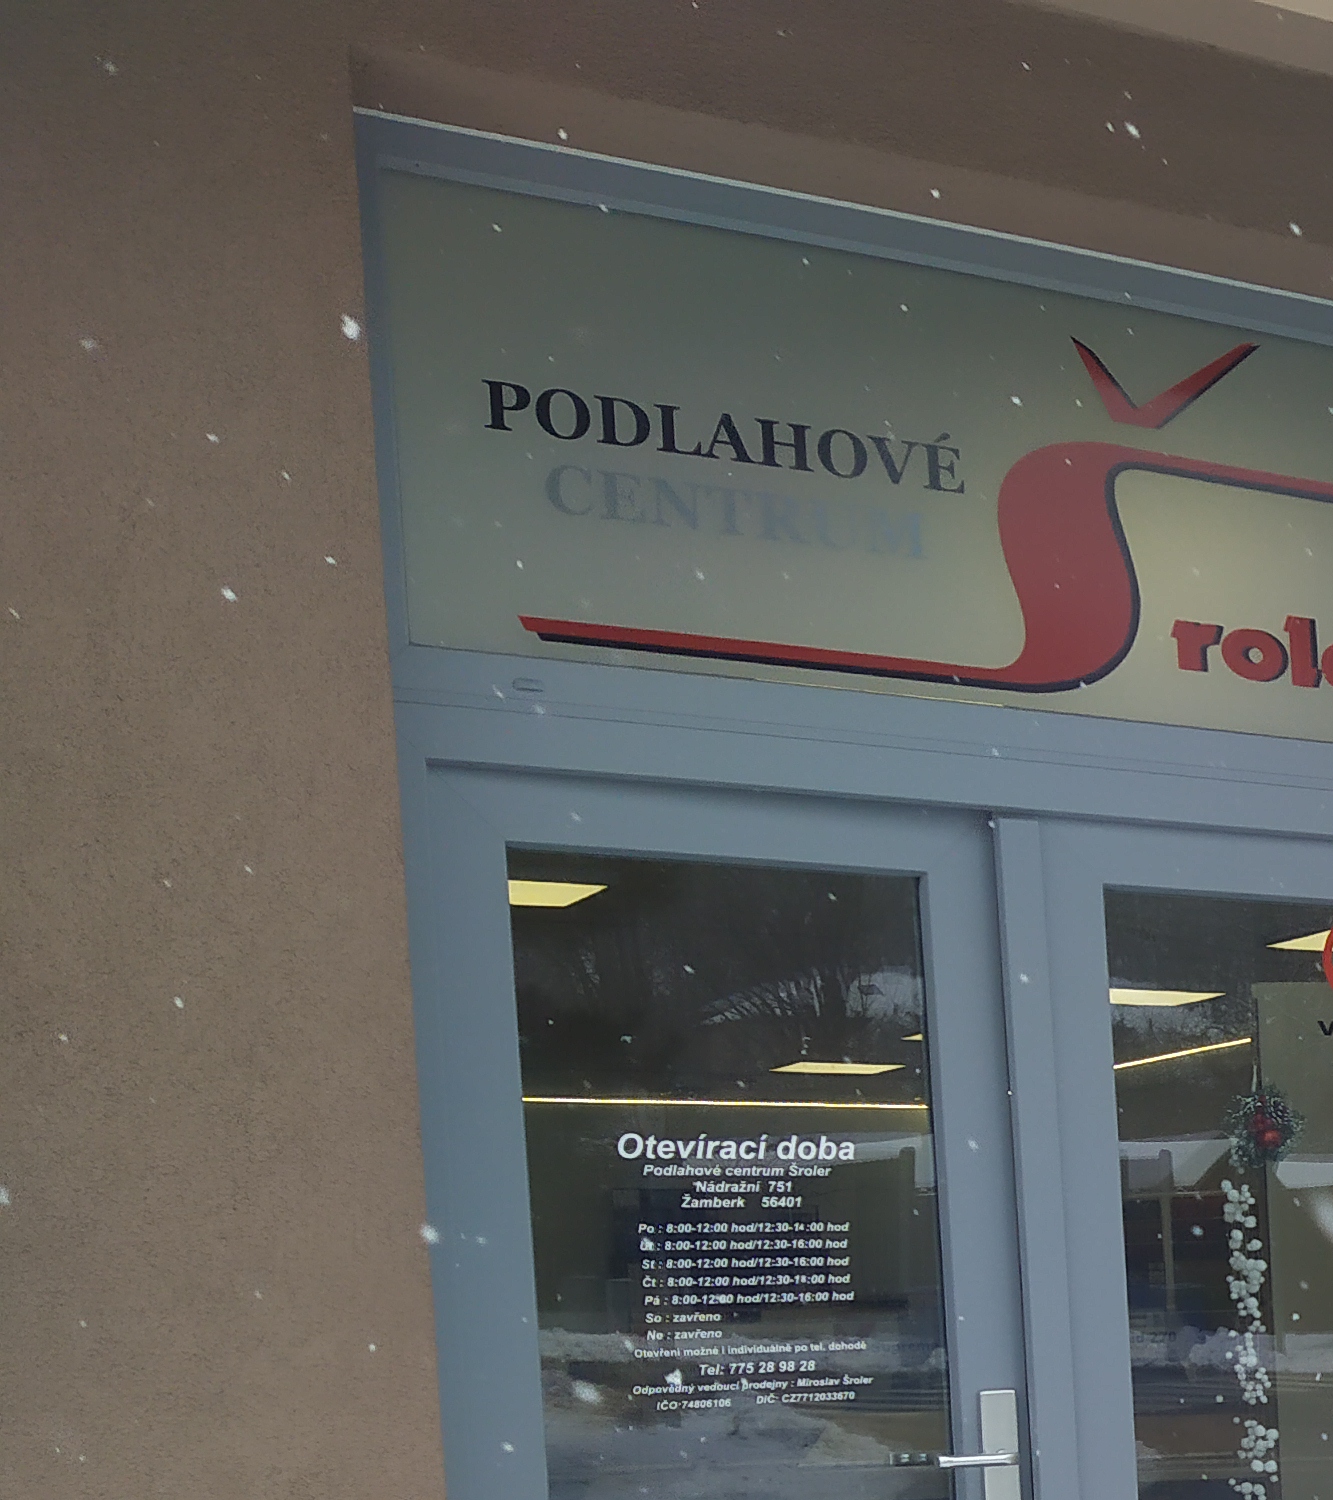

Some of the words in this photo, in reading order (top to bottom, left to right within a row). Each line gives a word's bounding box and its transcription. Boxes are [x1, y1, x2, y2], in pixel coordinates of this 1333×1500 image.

[482, 378, 966, 494] PODLAHOVÉ
[544, 463, 926, 559] CENTRUM
[617, 1133, 768, 1160] Otevírací
[776, 1135, 856, 1160] doba
[643, 1164, 721, 1177] Podlahové
[725, 1166, 784, 1177] centrum
[788, 1163, 832, 1177] Šroler
[695, 1180, 761, 1193] Nádražní
[768, 1180, 792, 1193] 751
[681, 1193, 746, 1208] Žamberk
[761, 1196, 802, 1208] 56401
[638, 1223, 655, 1233] Po
[666, 1223, 728, 1233] 8:00-12:00
[826, 1222, 850, 1232] hod
[664, 1240, 727, 1251] 8:00-12:00
[825, 1239, 848, 1249] hod
[642, 1259, 656, 1269] St
[666, 1259, 728, 1269] 8:00-12:00
[826, 1256, 850, 1266] hod
[642, 1275, 656, 1287] Čt
[667, 1276, 730, 1287] 8:00-12:00
[828, 1274, 851, 1284] hod
[644, 1295, 661, 1306] Pá
[832, 1291, 855, 1301] hod
[645, 1313, 662, 1323] So
[673, 1312, 721, 1322] zavřeno
[674, 1328, 723, 1340] zavřeno
[634, 1347, 681, 1359] Otevření
[684, 1346, 719, 1356] možné
[728, 1342, 792, 1355] individuálně
[795, 1344, 808, 1353] po
[810, 1342, 825, 1352] tel.
[828, 1340, 867, 1351] dohodě
[699, 1364, 725, 1376] Tel:
[728, 1362, 755, 1375] 775
[758, 1361, 775, 1373] 28
[779, 1360, 795, 1372] 98
[799, 1359, 816, 1371] 28
[633, 1383, 695, 1396] Odpovědný
[697, 1381, 740, 1392] vedoucí
[741, 1379, 789, 1391] prodejny
[797, 1376, 841, 1387] Miroslav
[842, 1374, 874, 1386] Šroler
